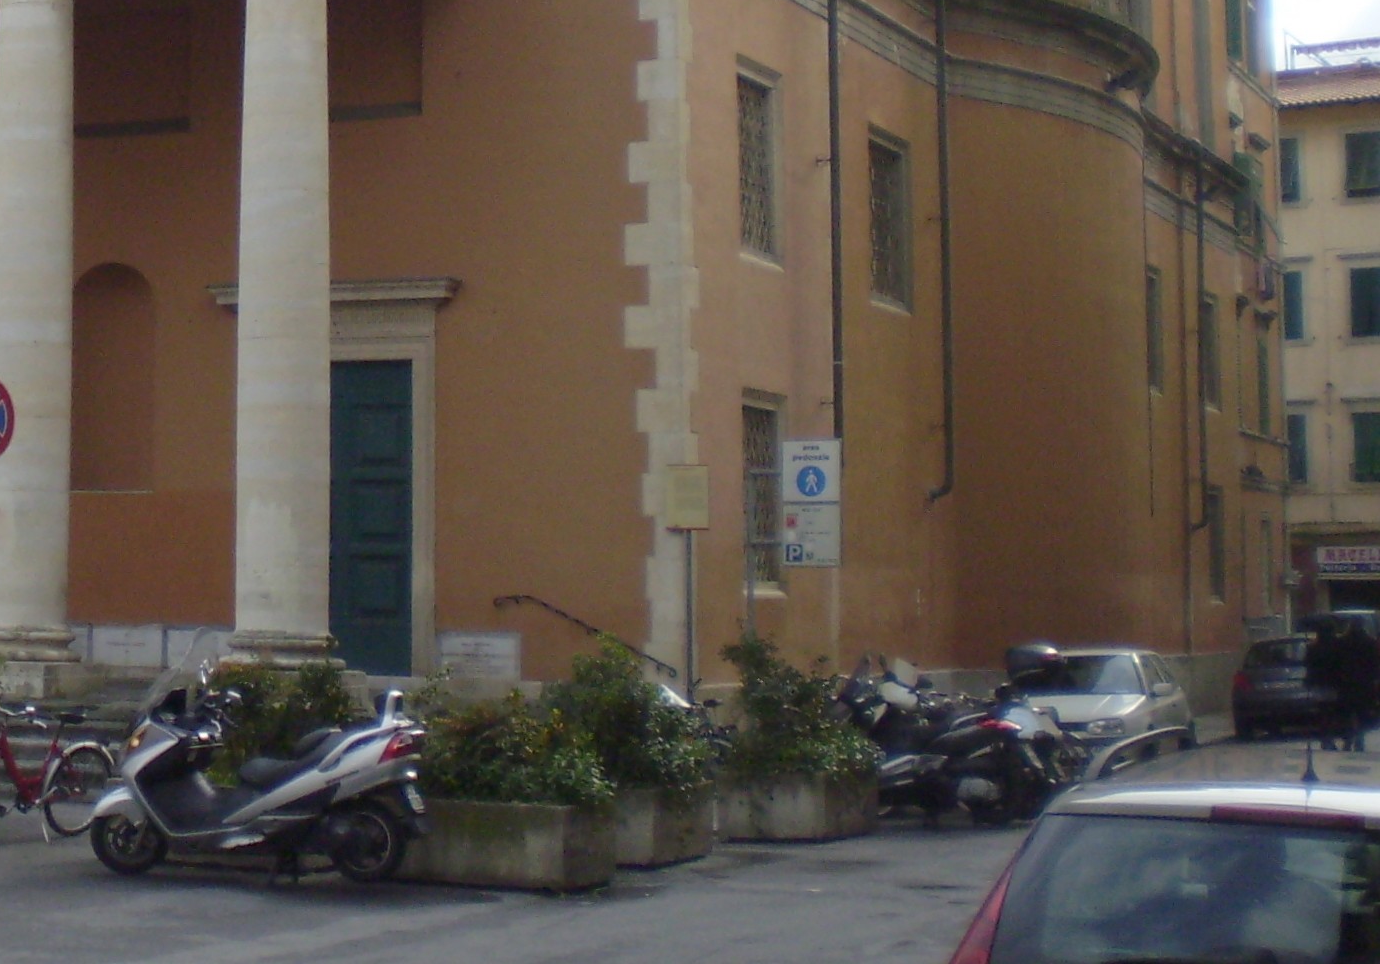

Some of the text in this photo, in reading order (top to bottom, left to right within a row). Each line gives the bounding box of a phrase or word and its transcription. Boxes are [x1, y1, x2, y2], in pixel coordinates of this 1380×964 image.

[802, 444, 820, 452] area
[792, 454, 830, 463] pedonale
[789, 545, 802, 562] P
